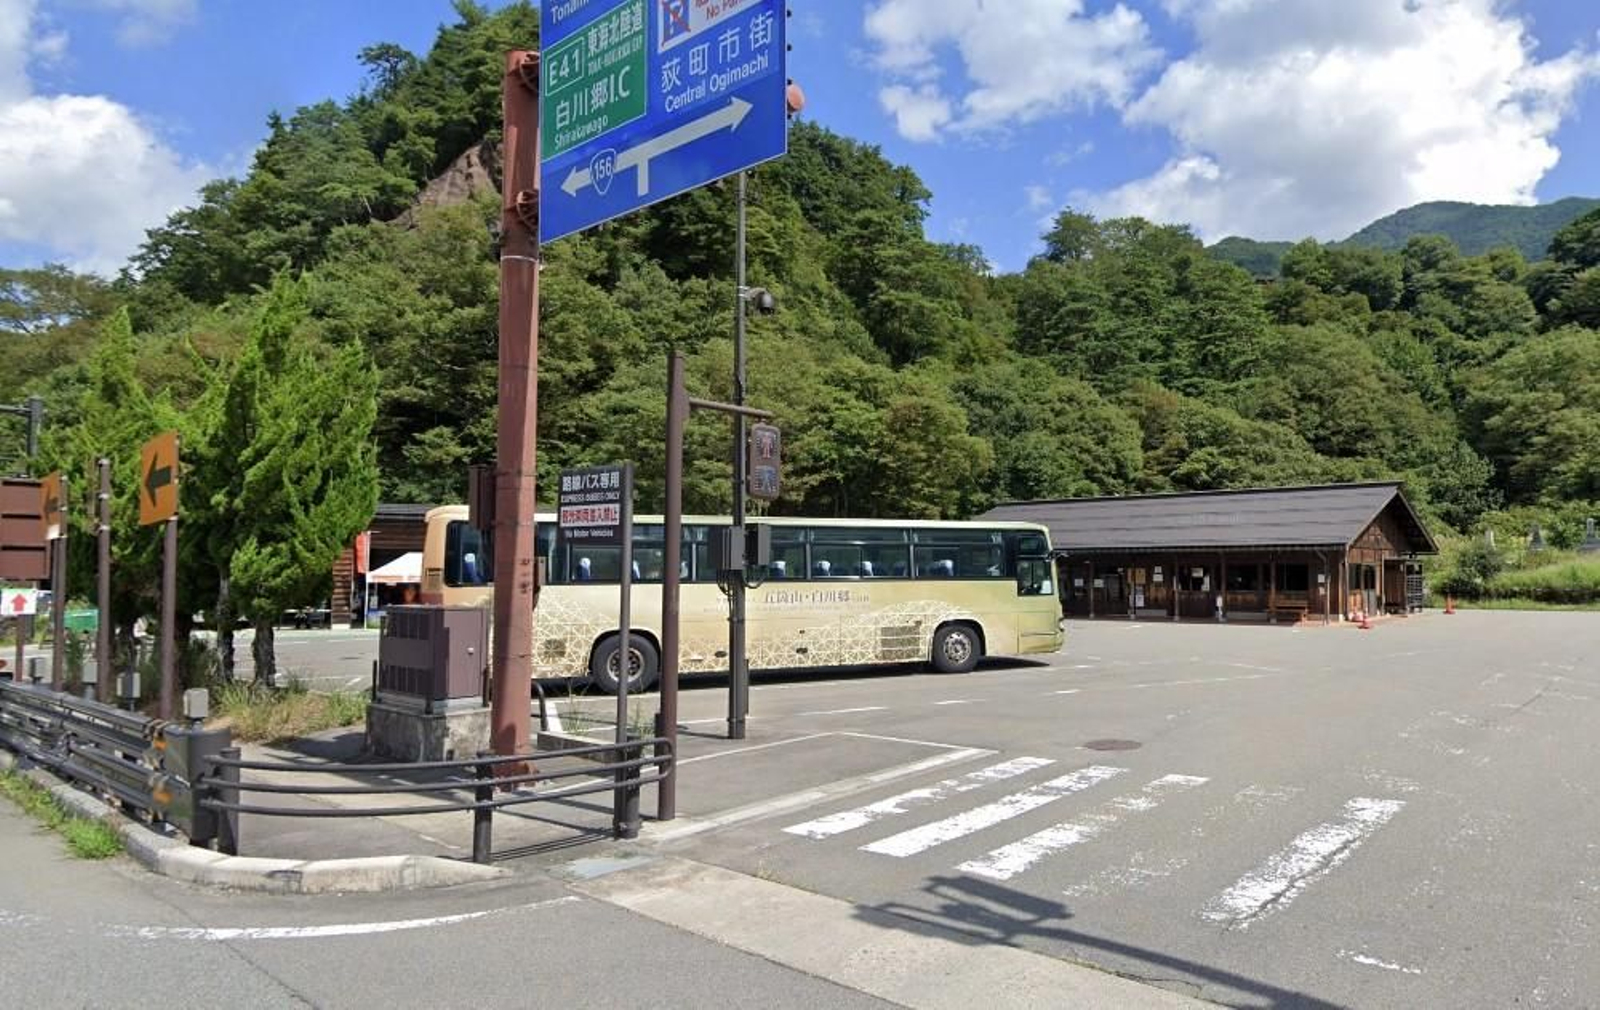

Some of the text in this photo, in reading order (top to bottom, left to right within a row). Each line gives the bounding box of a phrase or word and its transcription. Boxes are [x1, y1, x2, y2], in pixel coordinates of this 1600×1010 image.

[550, 0, 590, 26] Tonam
[549, 48, 579, 87] E41
[661, 10, 773, 93] 荻町市街
[665, 49, 769, 113] Central Ogimachi
[554, 114, 608, 150] Shirakawago
[594, 155, 612, 182] 156
[562, 471, 620, 491] 路線バス専用
